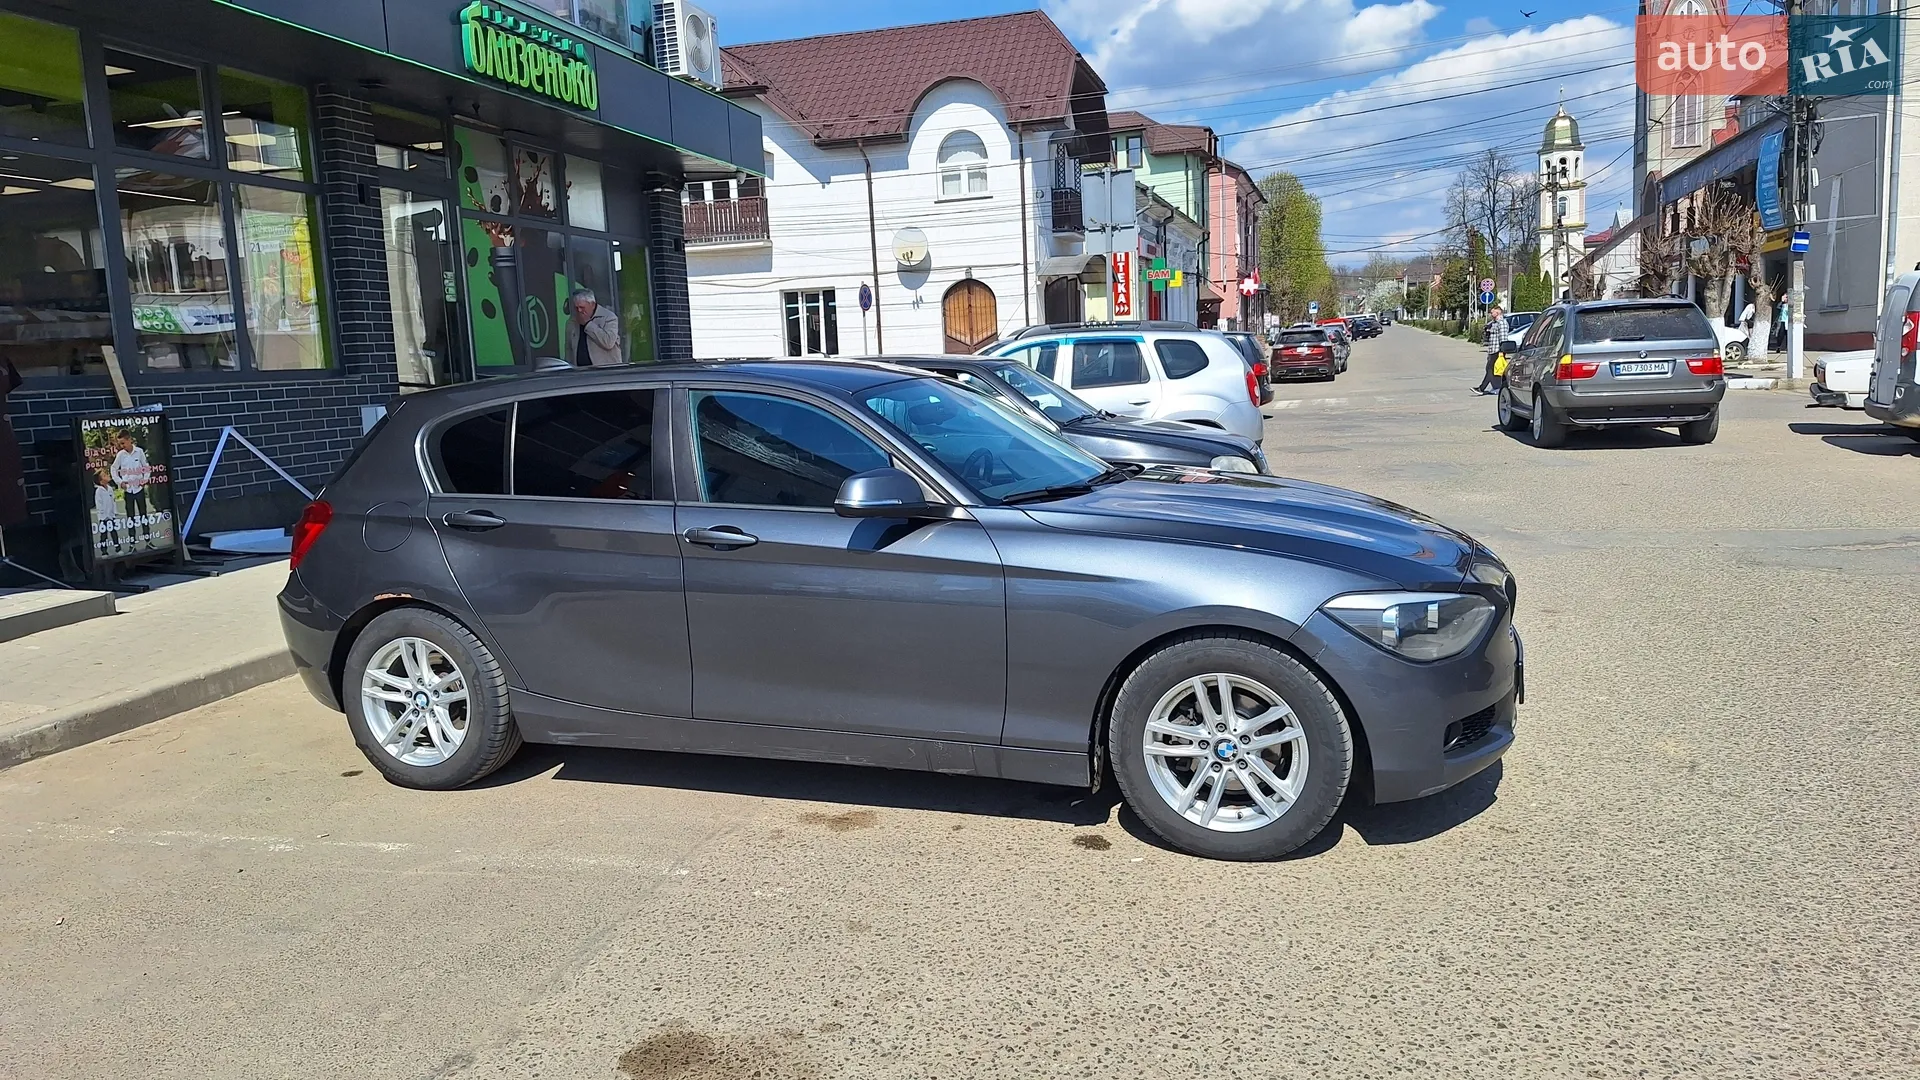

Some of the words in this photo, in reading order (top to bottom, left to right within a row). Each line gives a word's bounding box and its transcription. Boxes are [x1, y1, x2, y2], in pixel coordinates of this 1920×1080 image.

[1116, 254, 1126, 303] ПТЕКА
[1146, 269, 1171, 279] БАМ
[1634, 363, 1653, 372] 7303
[81, 417, 132, 431] Дитячий
[135, 415, 160, 426] одяг
[92, 512, 162, 535] 0683163467
